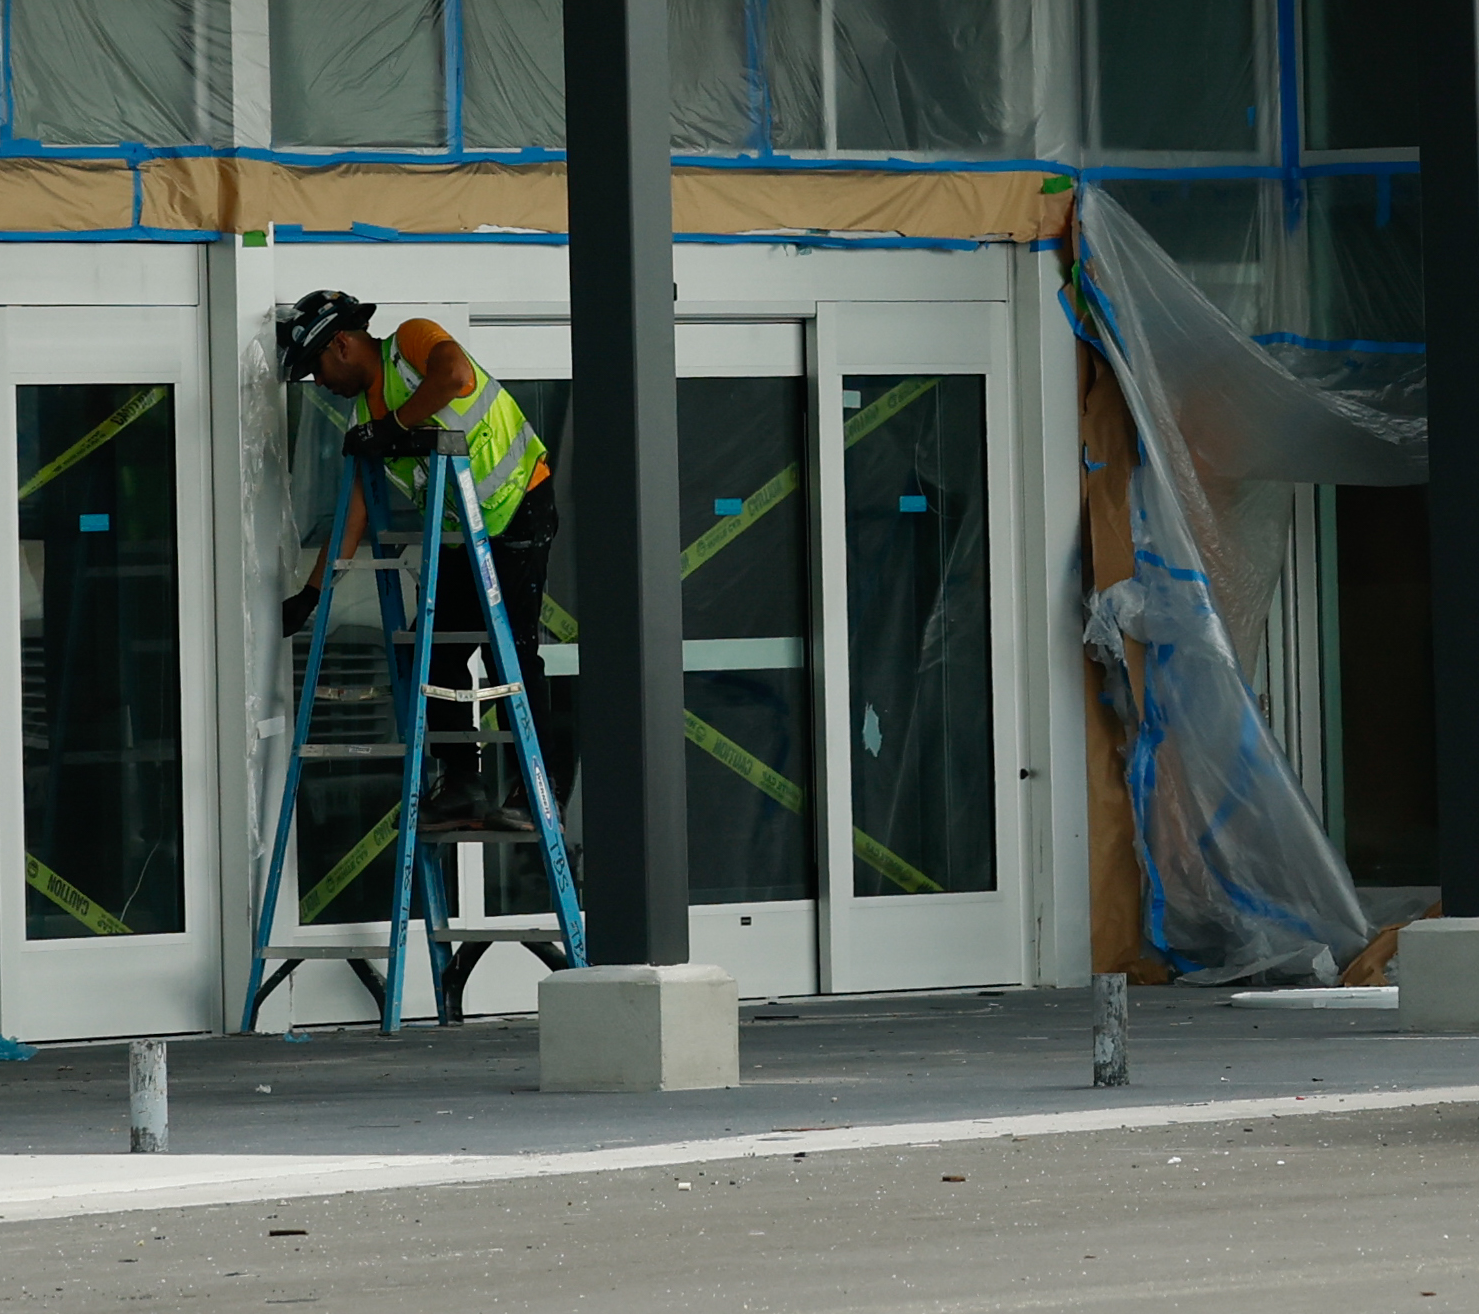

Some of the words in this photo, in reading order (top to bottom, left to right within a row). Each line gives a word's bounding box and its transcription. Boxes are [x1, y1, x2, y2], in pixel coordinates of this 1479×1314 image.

[536, 770, 551, 816] WERNER
[549, 833, 570, 894] TBS
[47, 874, 90, 917] CAUTION
